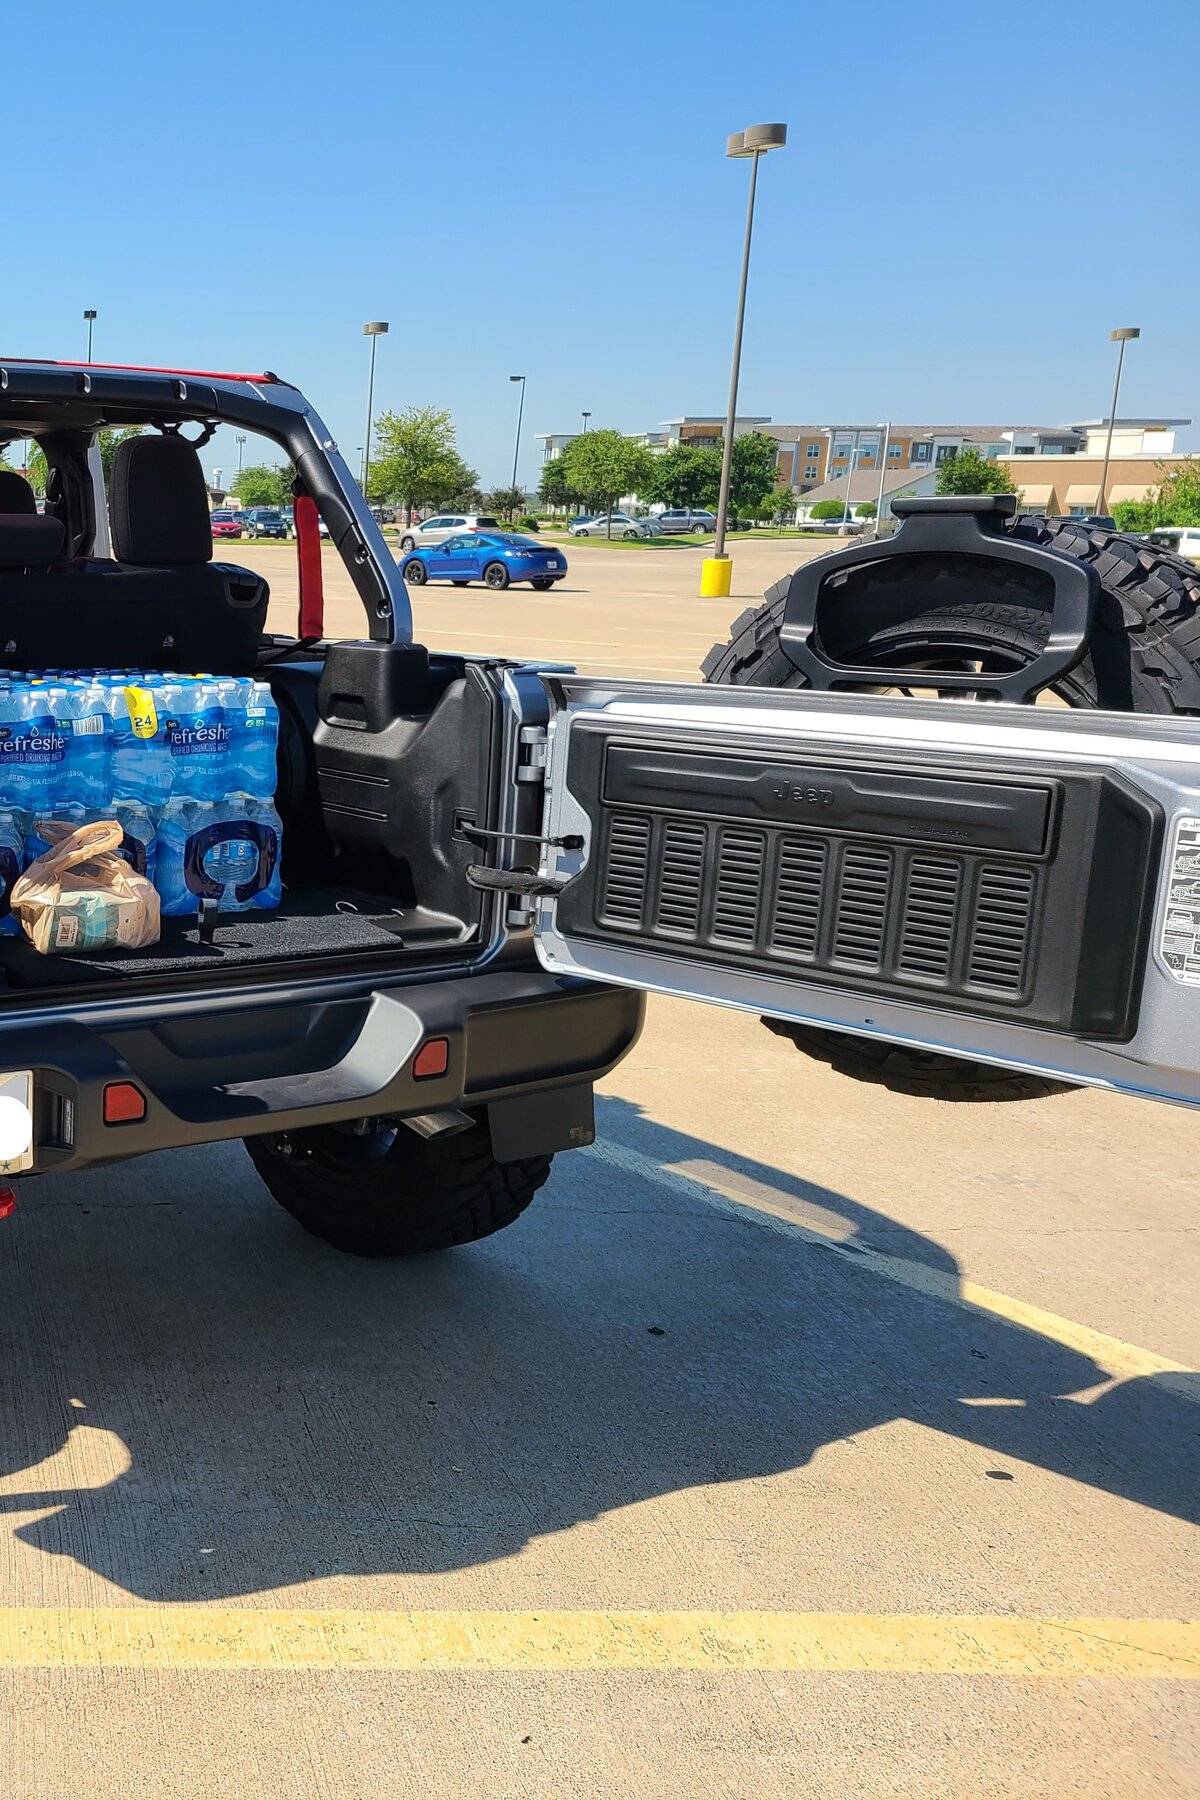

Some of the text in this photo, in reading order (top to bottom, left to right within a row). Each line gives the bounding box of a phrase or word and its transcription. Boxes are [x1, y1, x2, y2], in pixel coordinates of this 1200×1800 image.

[134, 715, 152, 727] 24
[171, 723, 230, 744] refreshe
[25, 753, 51, 762] DRINKING
[772, 780, 835, 807] Jeep
